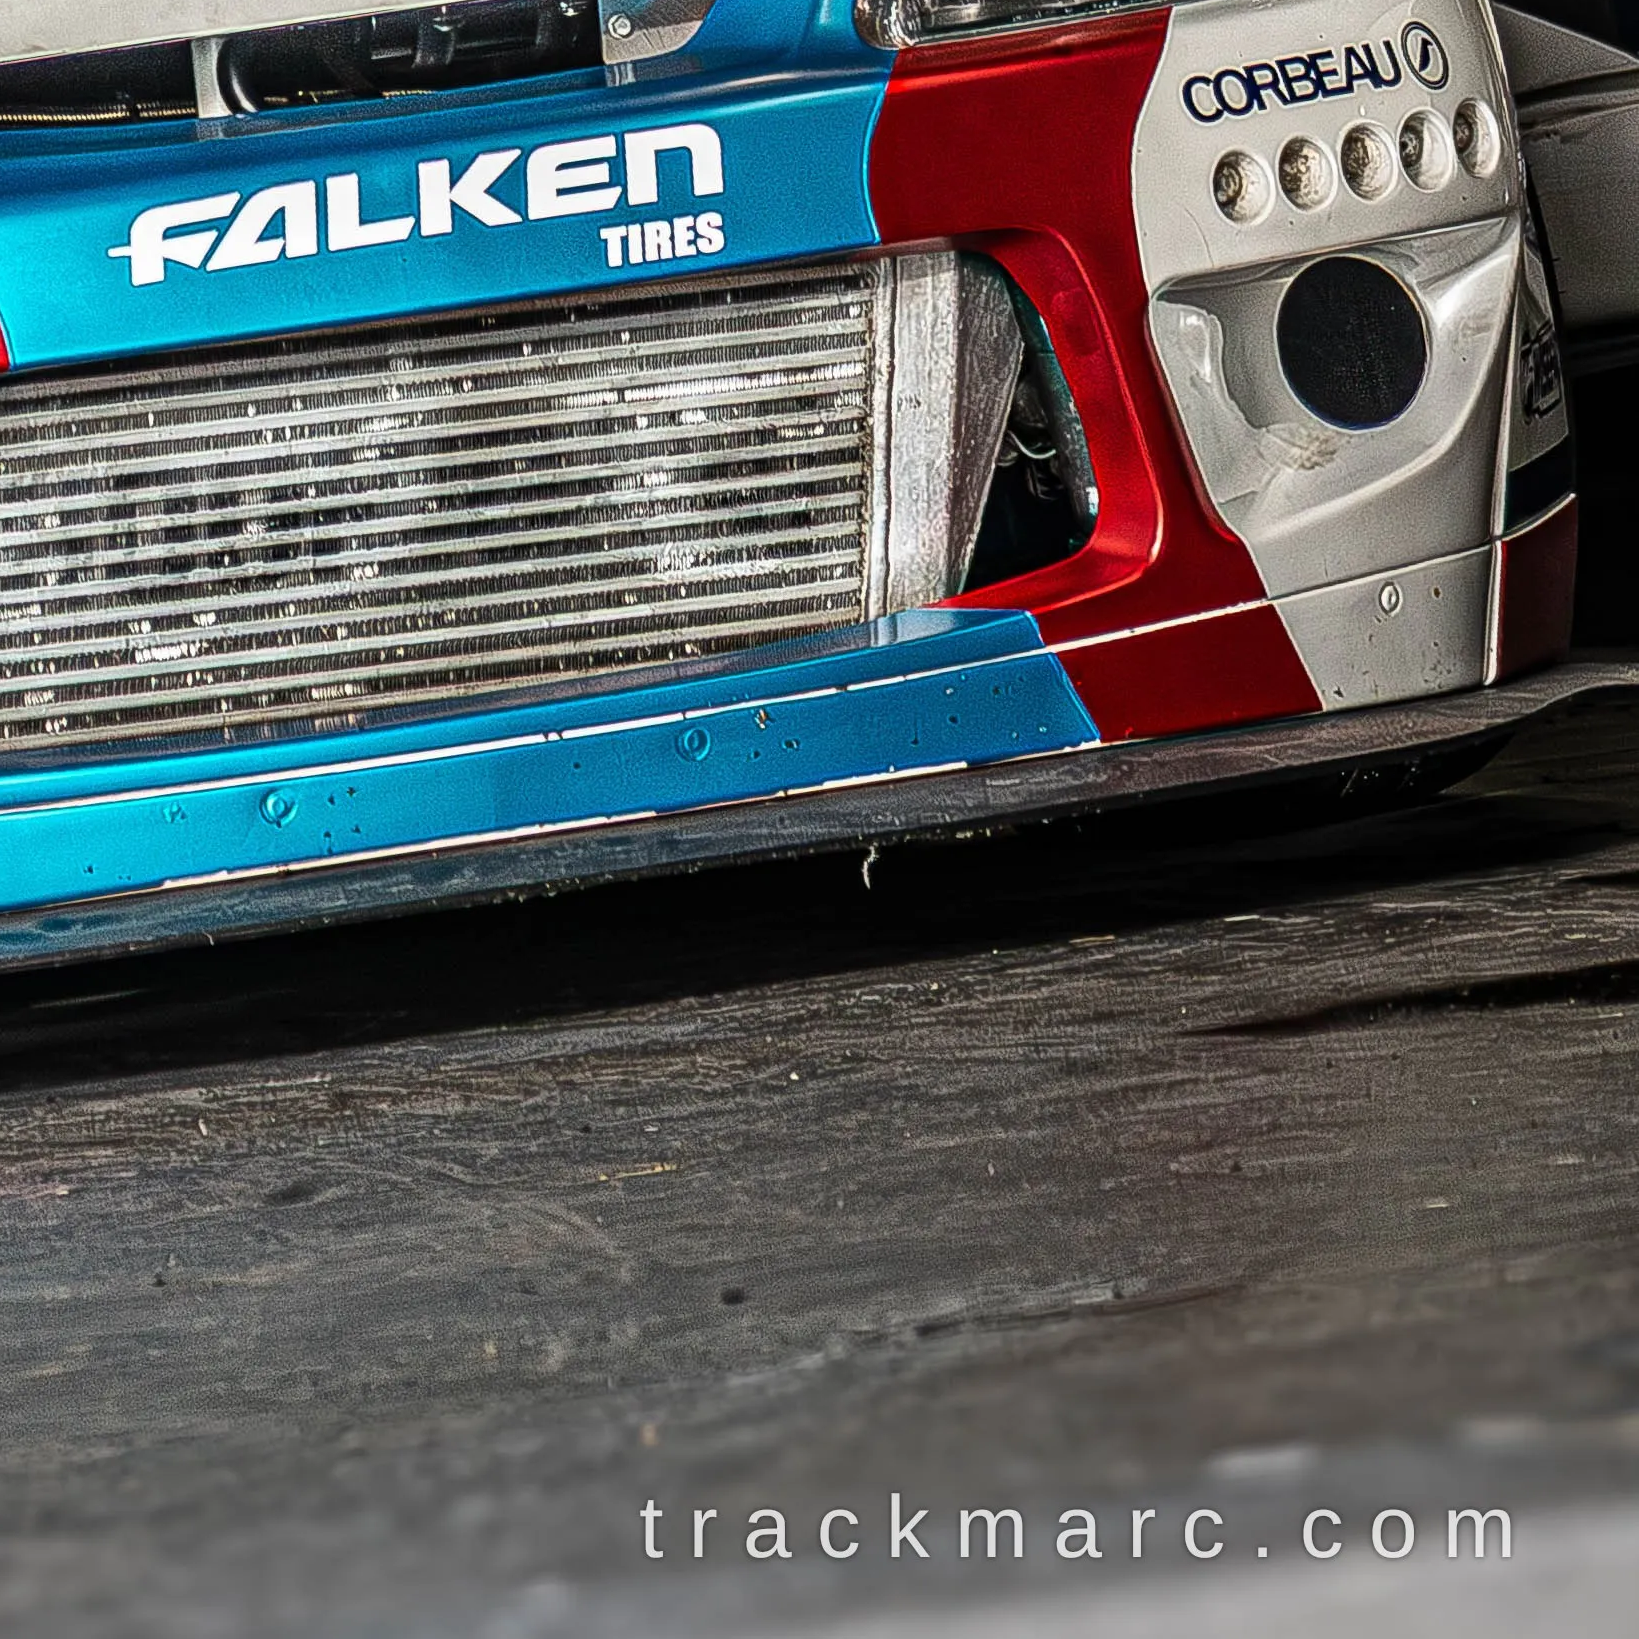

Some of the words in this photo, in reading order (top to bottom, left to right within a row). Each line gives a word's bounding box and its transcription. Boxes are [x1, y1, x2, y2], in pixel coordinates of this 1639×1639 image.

[1182, 39, 1402, 123] CORBEAU
[107, 122, 724, 288] FALKEN
[599, 211, 726, 269] TIRES
